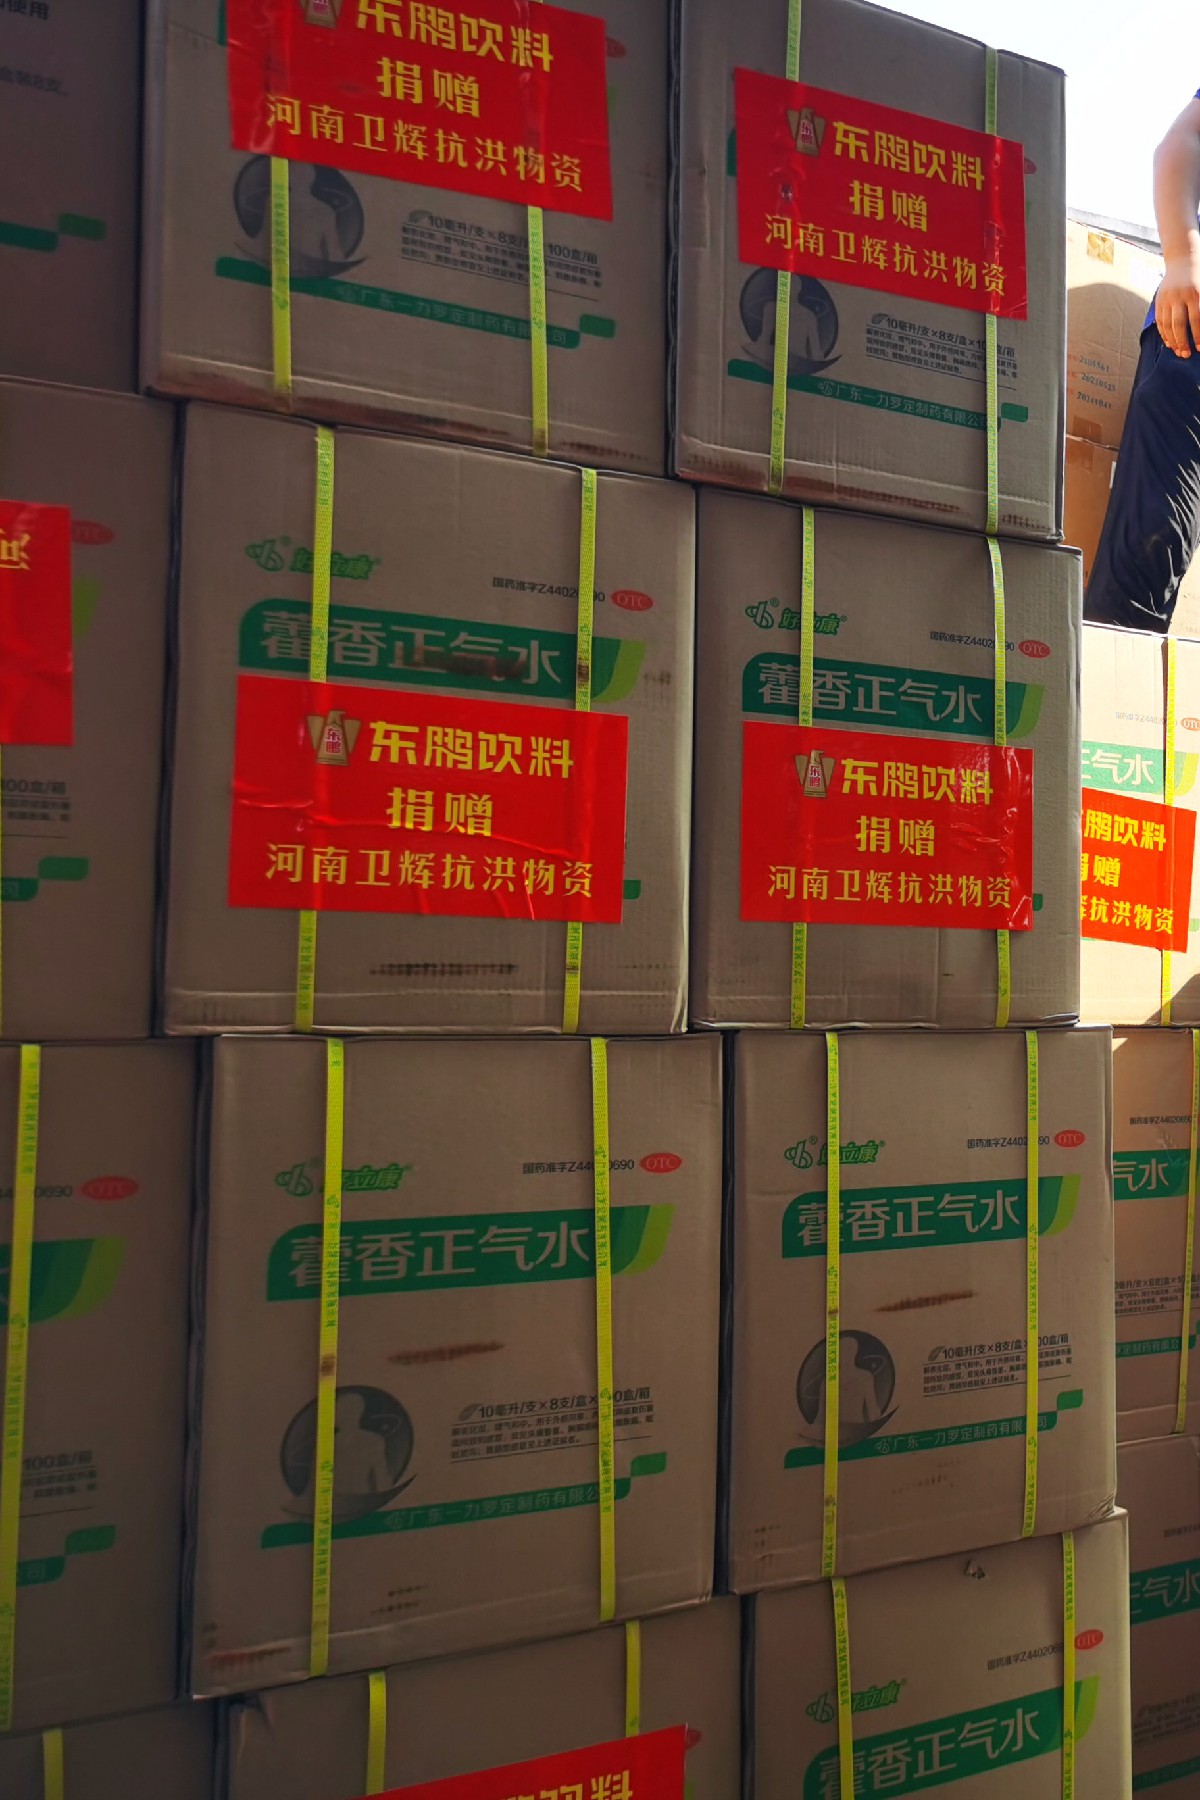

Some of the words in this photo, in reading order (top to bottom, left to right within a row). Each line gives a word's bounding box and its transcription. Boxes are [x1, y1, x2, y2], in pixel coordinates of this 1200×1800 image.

[356, 0, 553, 72] 东鹏饮料
[376, 57, 481, 118] 捐赠
[266, 94, 583, 192] 河南卫辉抗洪物资
[832, 120, 985, 191] 东鹏饮料
[848, 179, 929, 232] 捐赠
[764, 214, 1006, 296] 河南卫辉抗洪物资
[614, 592, 651, 610] OTC
[1021, 641, 1049, 657] OTC
[758, 661, 982, 724] 藿香正气水
[370, 721, 574, 779] 东鹏饮料
[841, 757, 994, 806] 东鹏饮料
[385, 786, 494, 837] 捐赠
[855, 815, 935, 857] 捐赠
[1082, 808, 1167, 852] 鹏饮料
[264, 844, 594, 898] 河南卫辉抗洪物资
[767, 865, 1012, 909] 河南卫辉抗洪物资
[643, 1155, 680, 1171] OTC
[1056, 1132, 1083, 1146] OTC
[797, 1189, 1020, 1247] 藿香正气水
[288, 1221, 590, 1287] 藿香正气水
[1076, 1632, 1101, 1649] OTC
